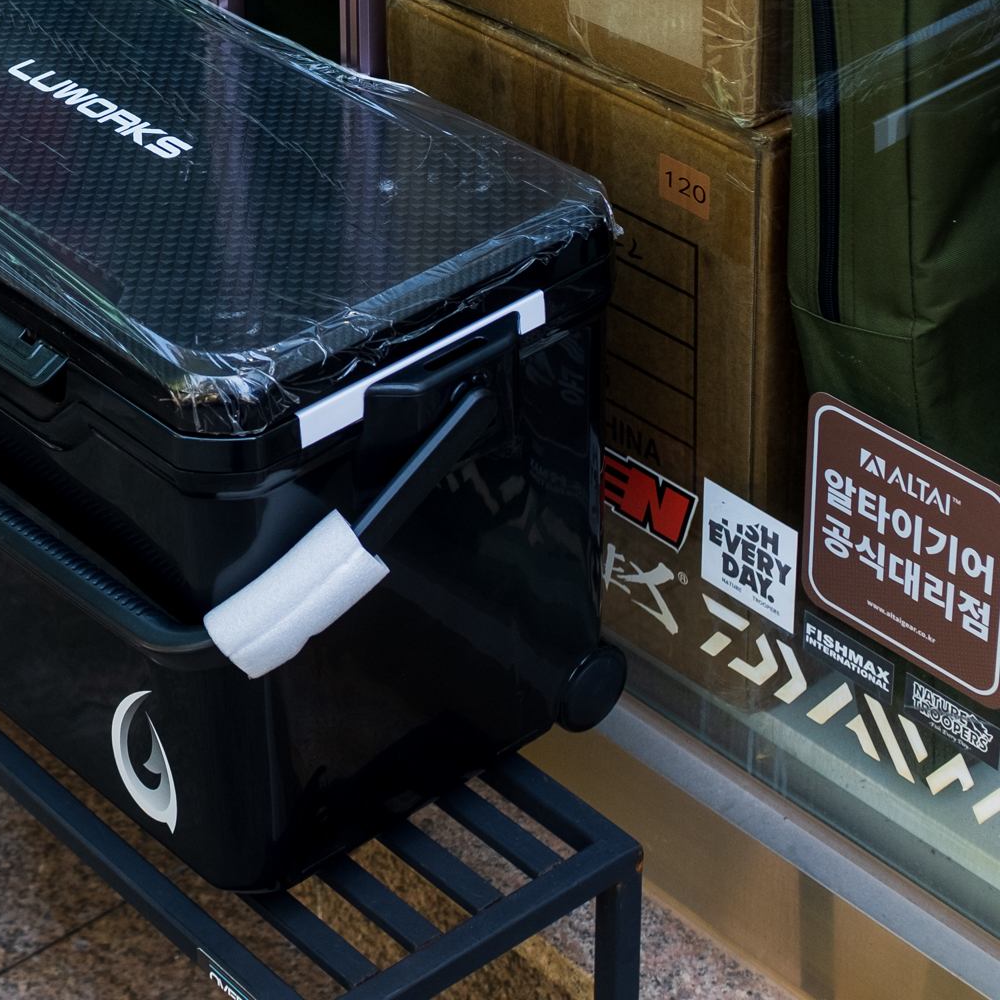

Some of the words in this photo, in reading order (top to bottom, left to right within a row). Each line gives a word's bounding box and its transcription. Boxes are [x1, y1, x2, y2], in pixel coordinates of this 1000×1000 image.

[7, 58, 193, 159] LUWORKS
[664, 170, 706, 204] 120
[606, 416, 661, 467] HINA
[708, 519, 792, 586] EVERY
[824, 468, 994, 596] 알타이기어
[721, 577, 743, 593] NATURE
[752, 595, 781, 616] TROOPERS
[822, 514, 991, 642] 공식대리점
[866, 599, 937, 644] www.altaigear.co.kr
[805, 622, 891, 684] FISHMAX
[805, 635, 890, 692] INTERNATIONAL
[912, 681, 968, 726] NATURE
[912, 696, 989, 753] TROOPERS
